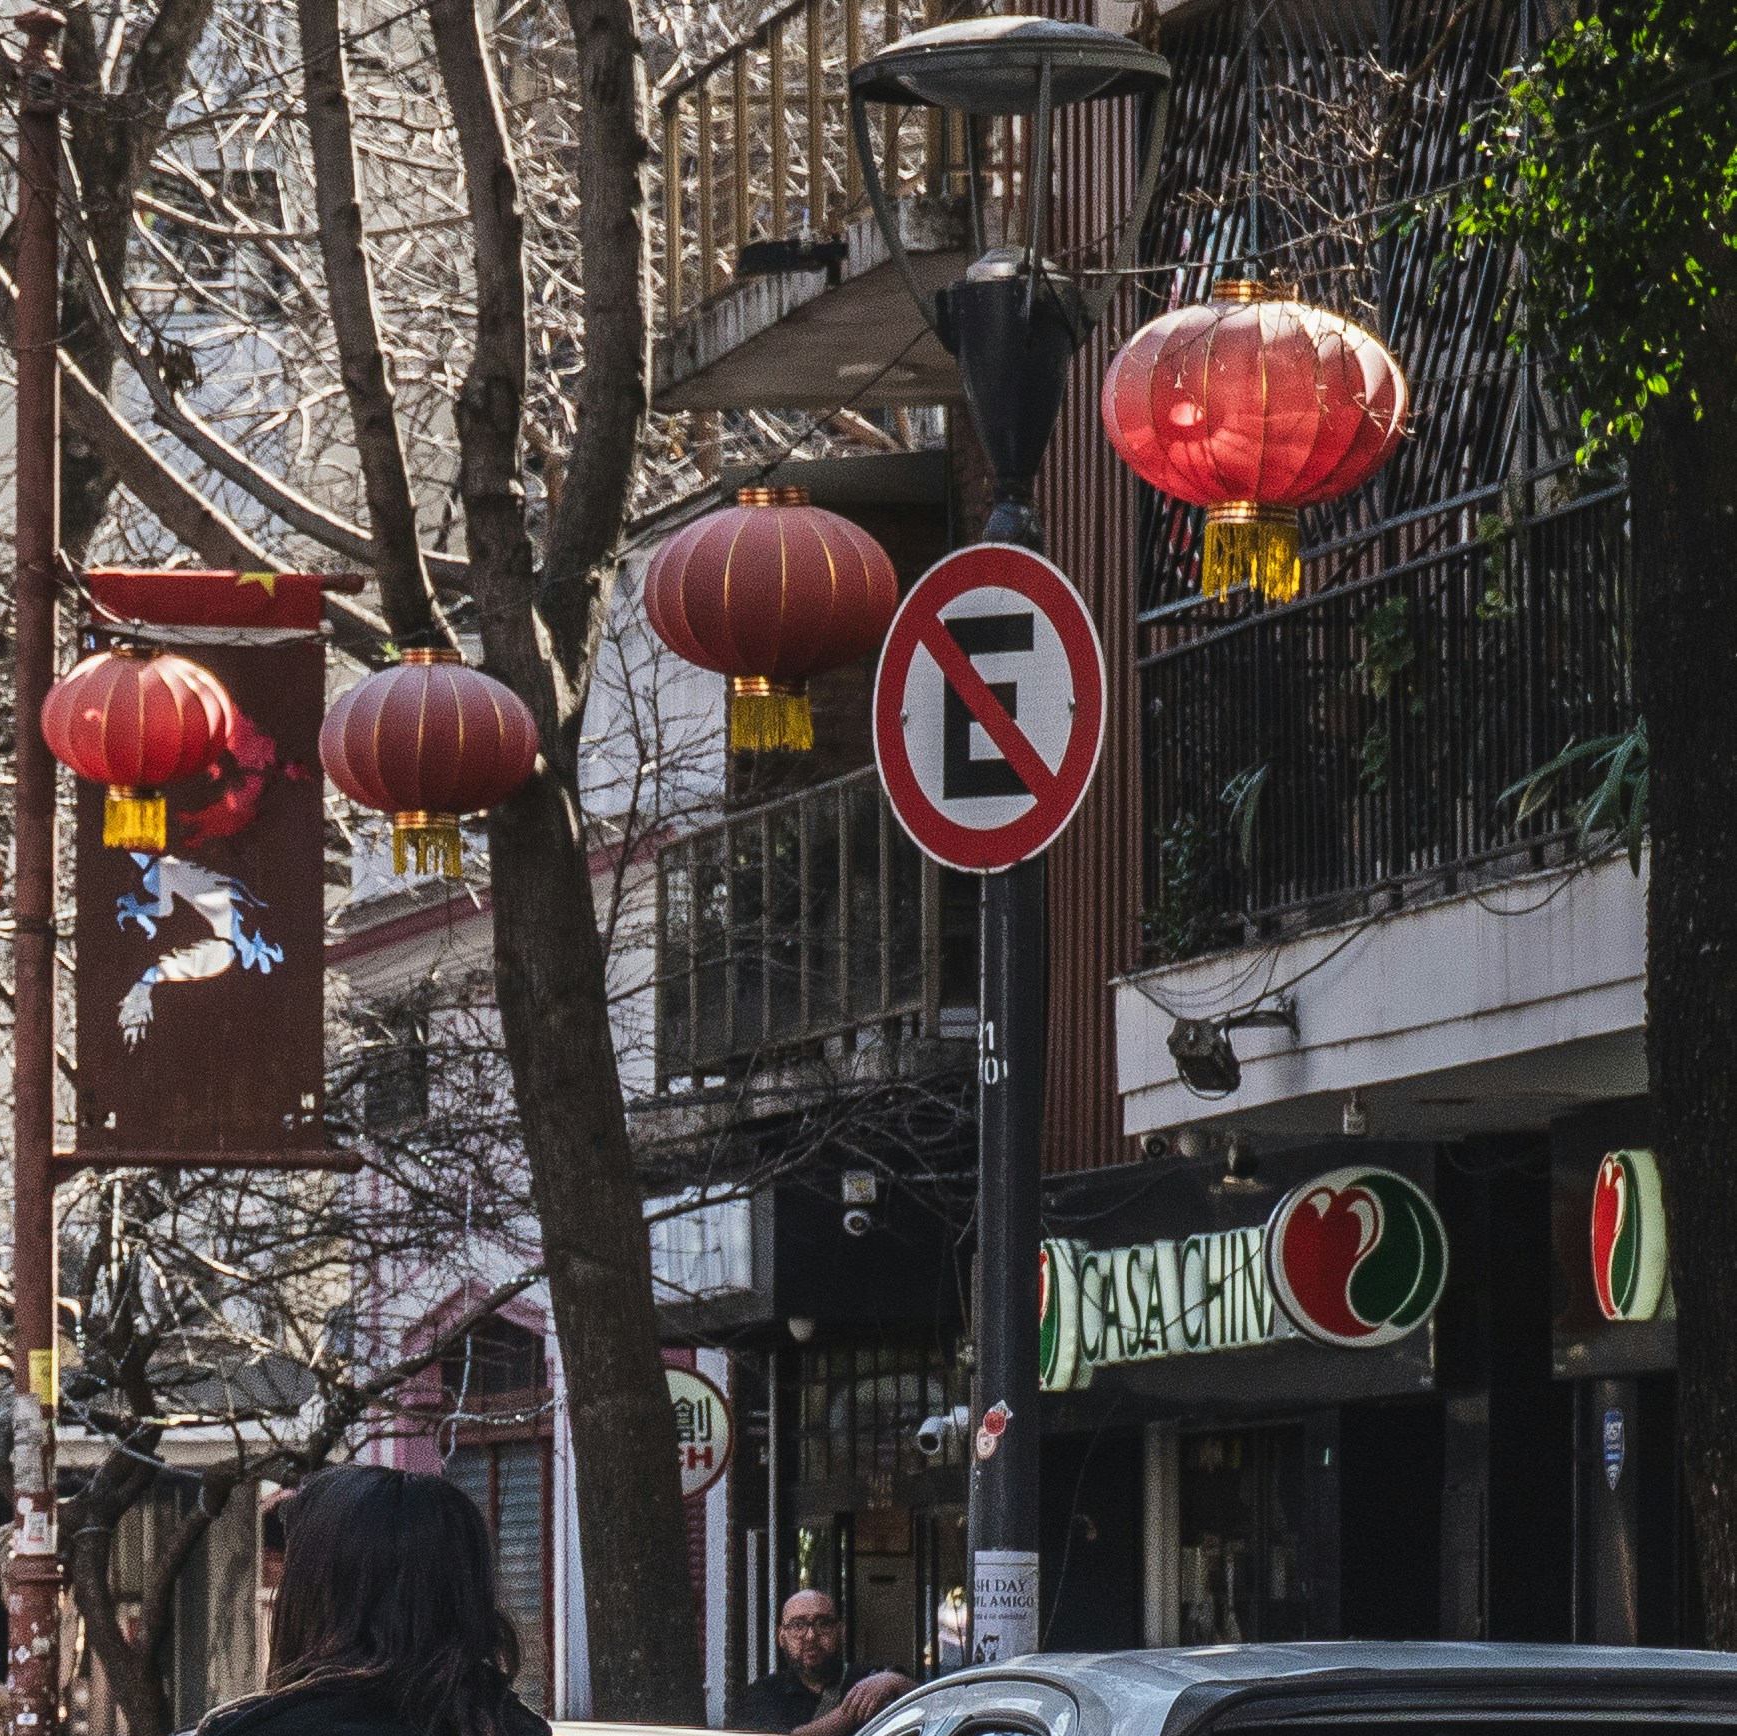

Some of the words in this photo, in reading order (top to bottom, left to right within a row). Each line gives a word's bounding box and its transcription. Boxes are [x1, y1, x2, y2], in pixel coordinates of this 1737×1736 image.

[1079, 1247, 1170, 1362] CASA
[1180, 1226, 1275, 1348] CHIN
[995, 1579, 1028, 1592] DAY
